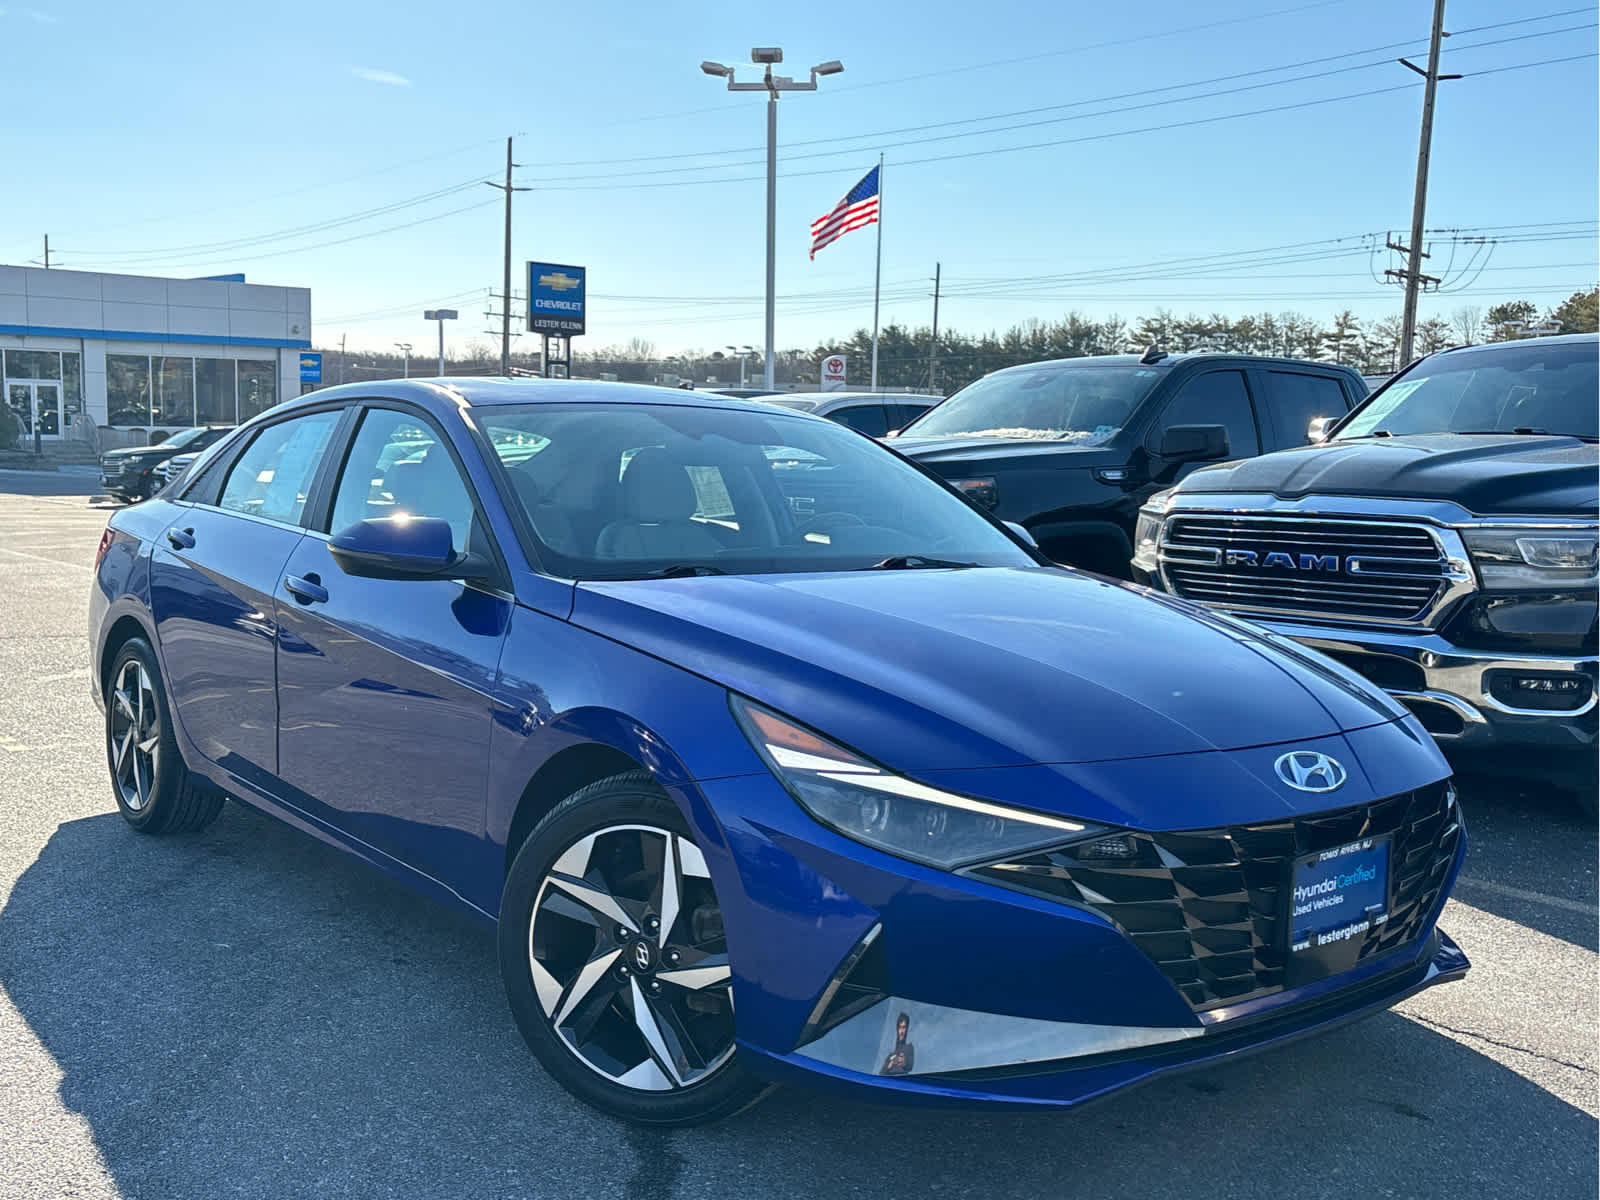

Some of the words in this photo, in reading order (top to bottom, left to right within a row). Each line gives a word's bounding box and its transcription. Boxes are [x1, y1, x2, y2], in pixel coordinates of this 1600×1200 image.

[535, 299, 582, 311] CHEVROLET
[535, 319, 560, 328] LESTER
[560, 320, 582, 329] GLENN
[1226, 549, 1339, 571] RAM
[1313, 894, 1344, 911] Vehicles
[1318, 921, 1369, 946] lesterglenn
